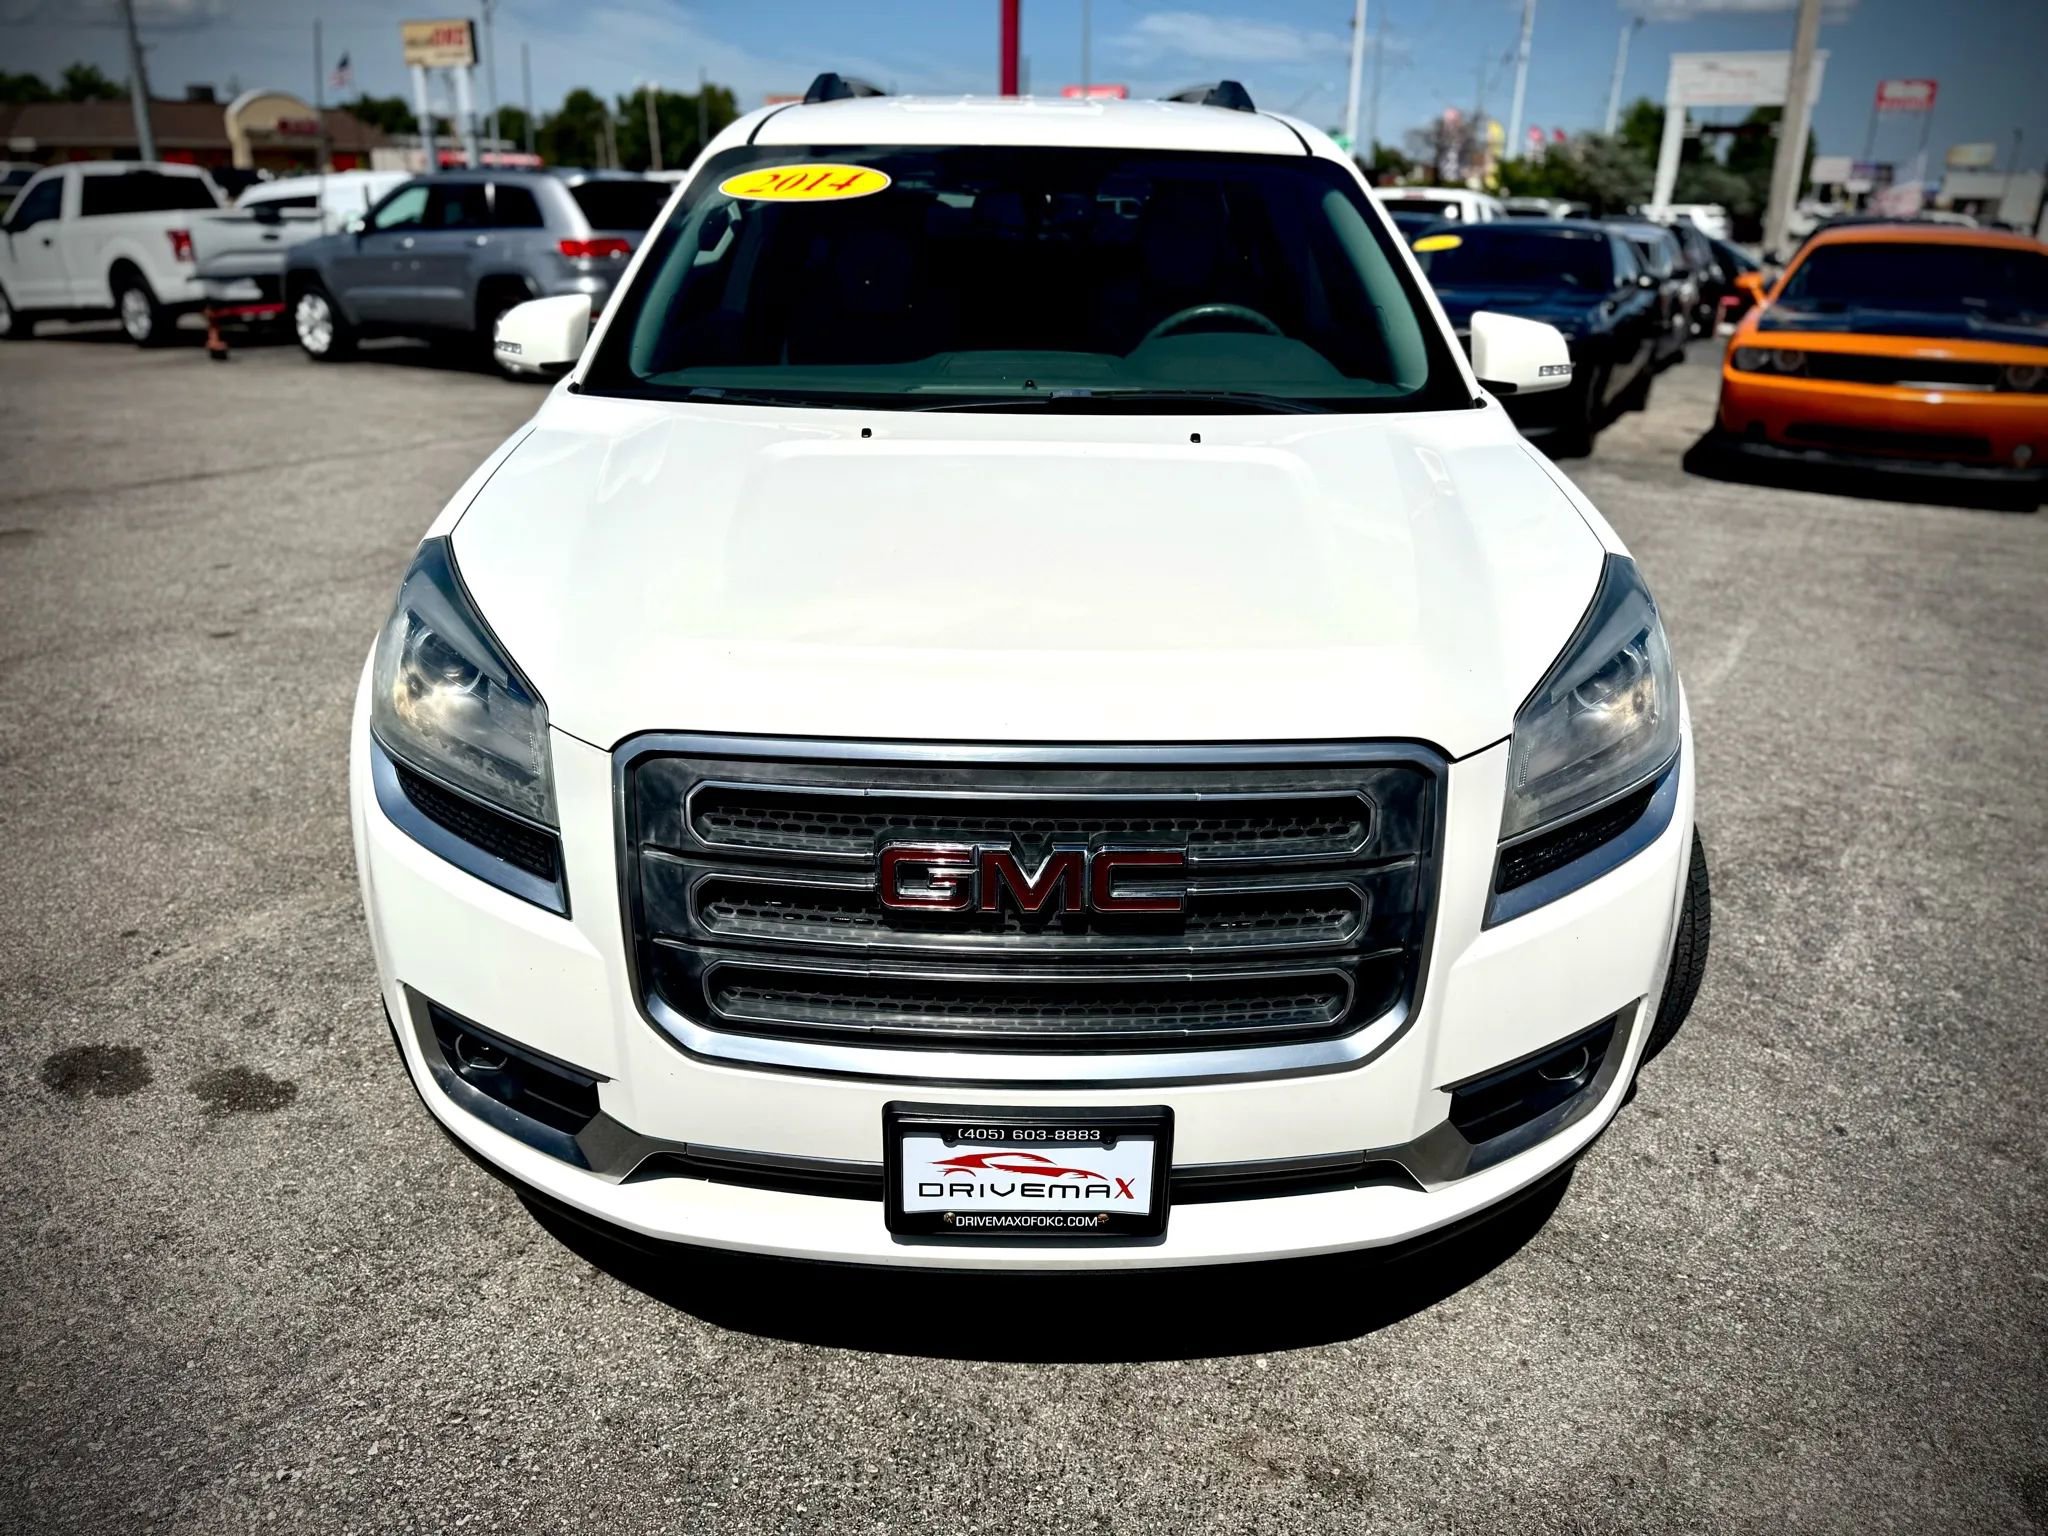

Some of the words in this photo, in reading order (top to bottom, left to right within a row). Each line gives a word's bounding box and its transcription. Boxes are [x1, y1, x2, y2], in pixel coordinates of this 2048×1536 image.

[744, 171, 866, 193] 2014
[877, 839, 1188, 914] GMC
[957, 1127, 1005, 1141] (405)
[1012, 1128, 1101, 1142] 603-8883
[918, 1177, 1136, 1200] DRIVEMAX
[955, 1215, 1099, 1228] DRIVEMAXOFOKC.COM
